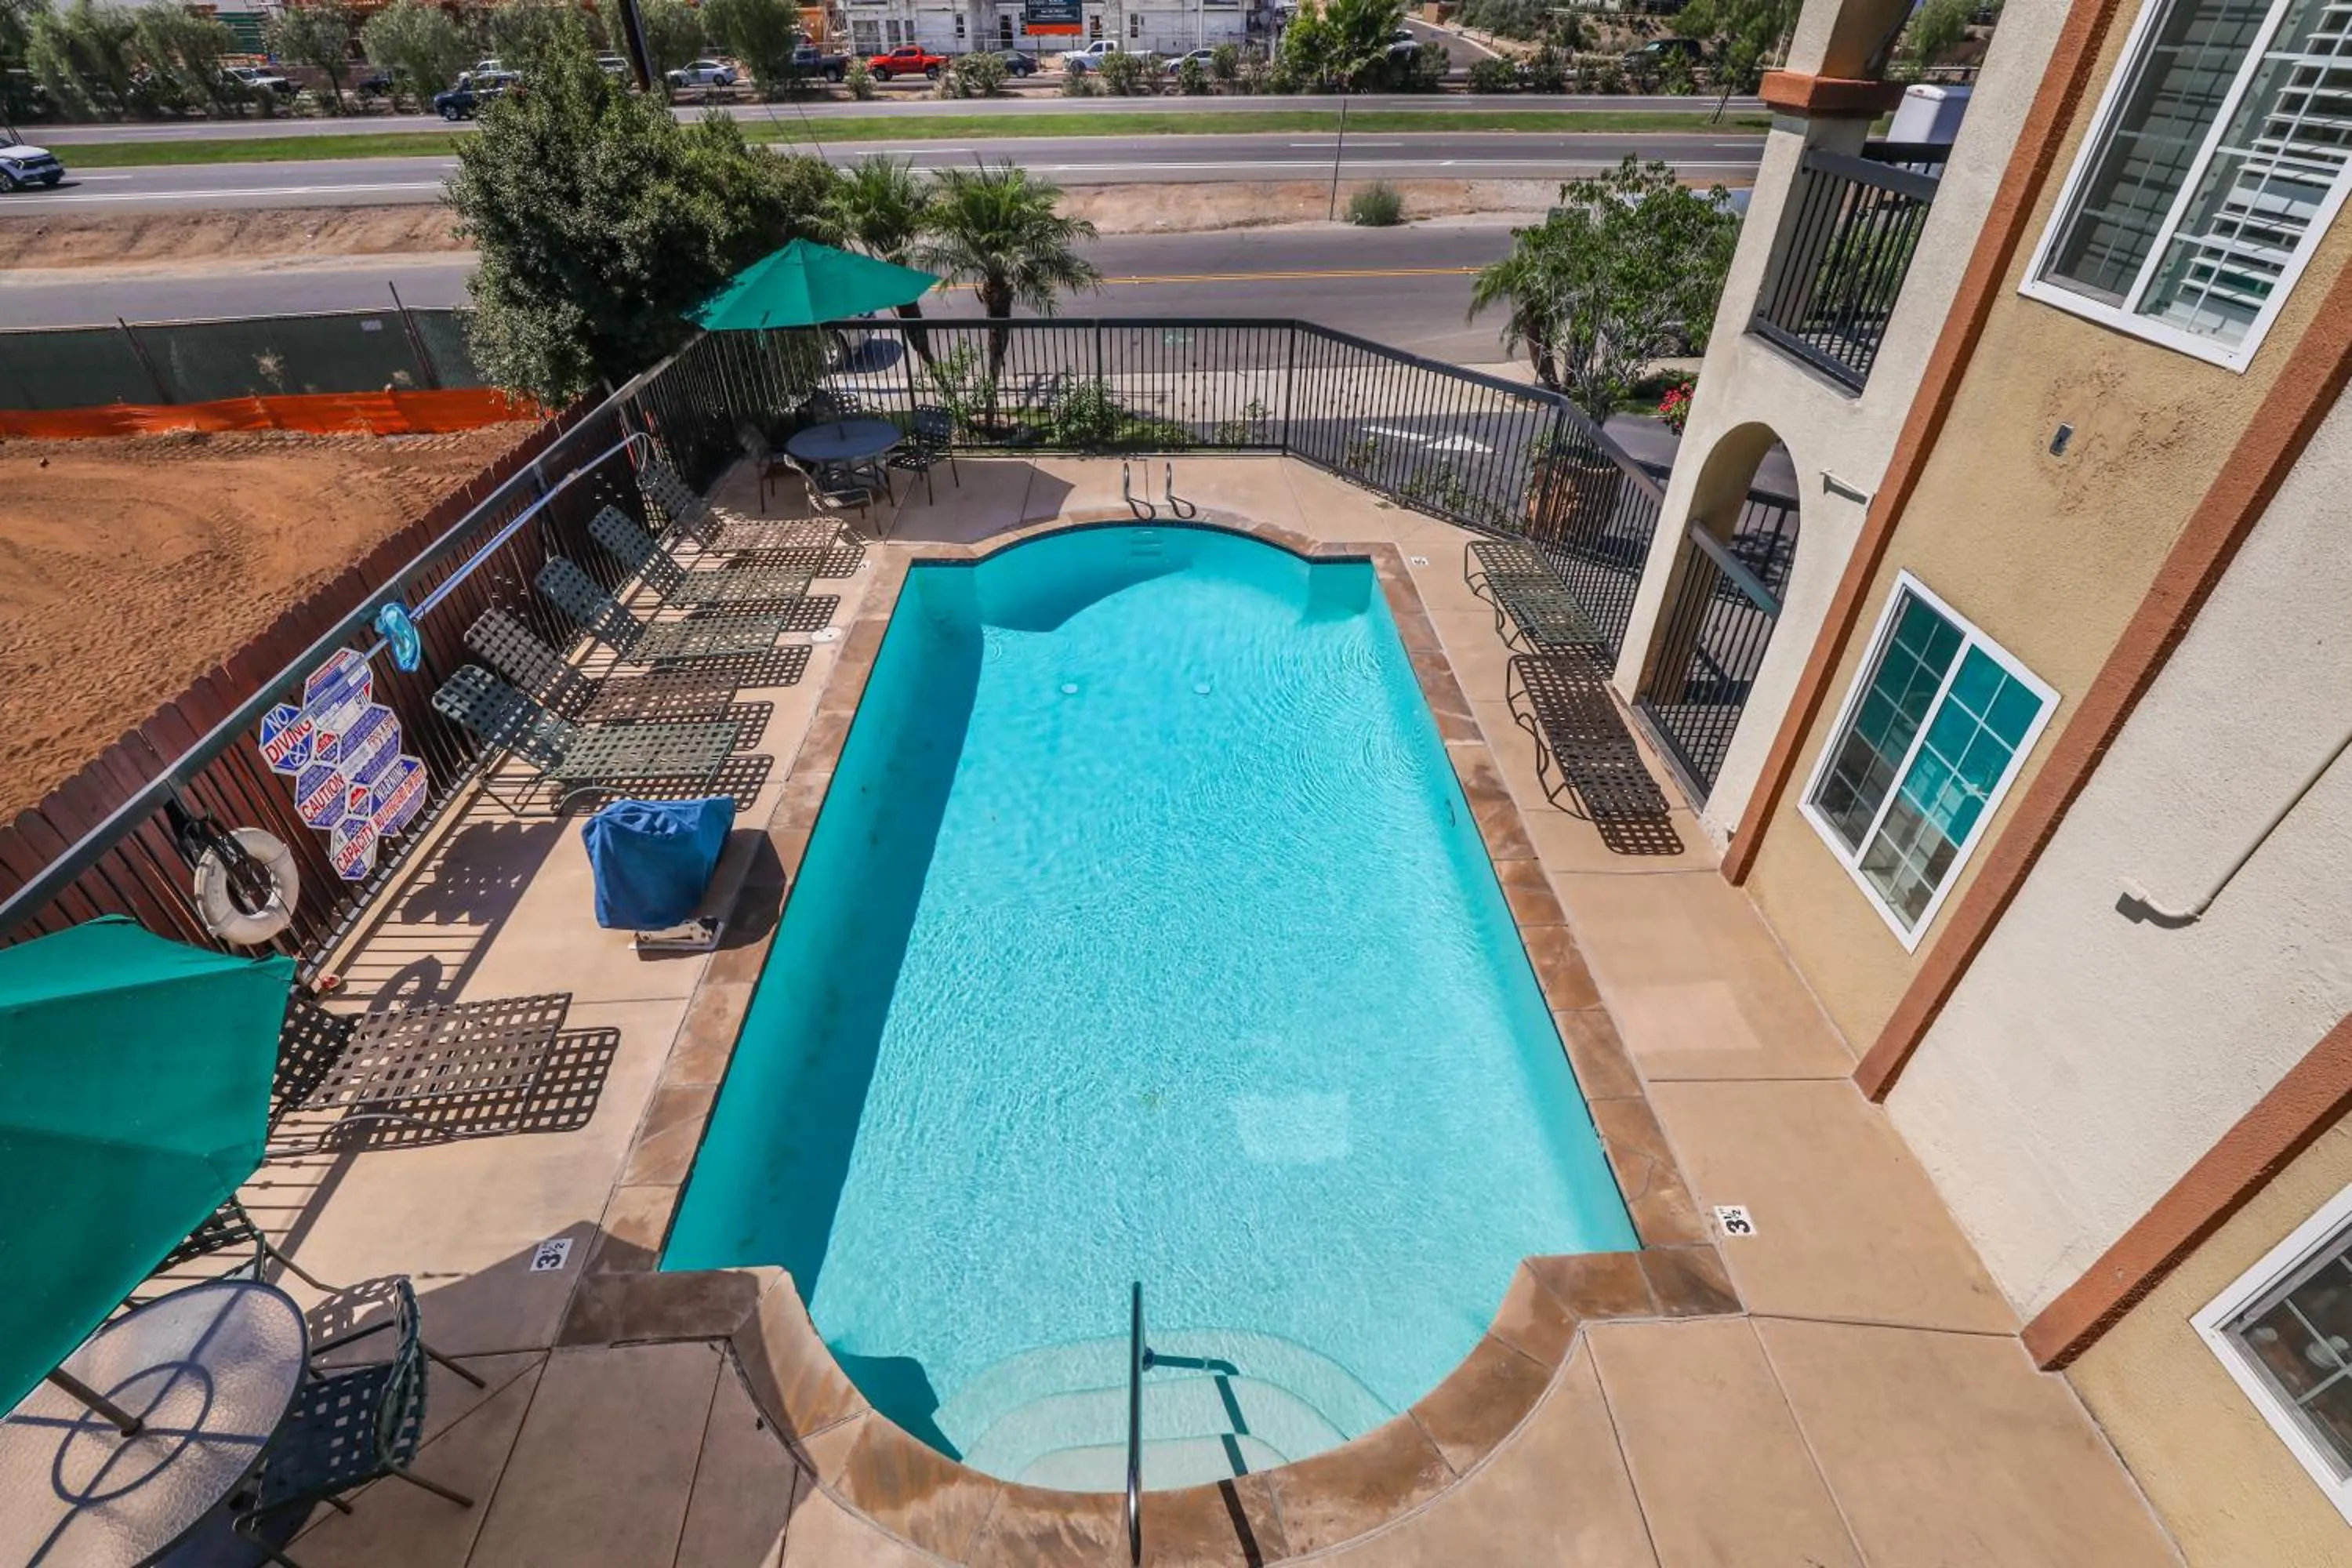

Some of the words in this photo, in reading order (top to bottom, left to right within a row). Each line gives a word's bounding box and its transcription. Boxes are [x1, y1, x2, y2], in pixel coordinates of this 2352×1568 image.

[265, 720, 312, 764] DIVING
[266, 707, 289, 734] NO
[302, 771, 345, 820] CAUTION
[375, 760, 408, 804] WARNING
[337, 826, 376, 873] CAPACITY
